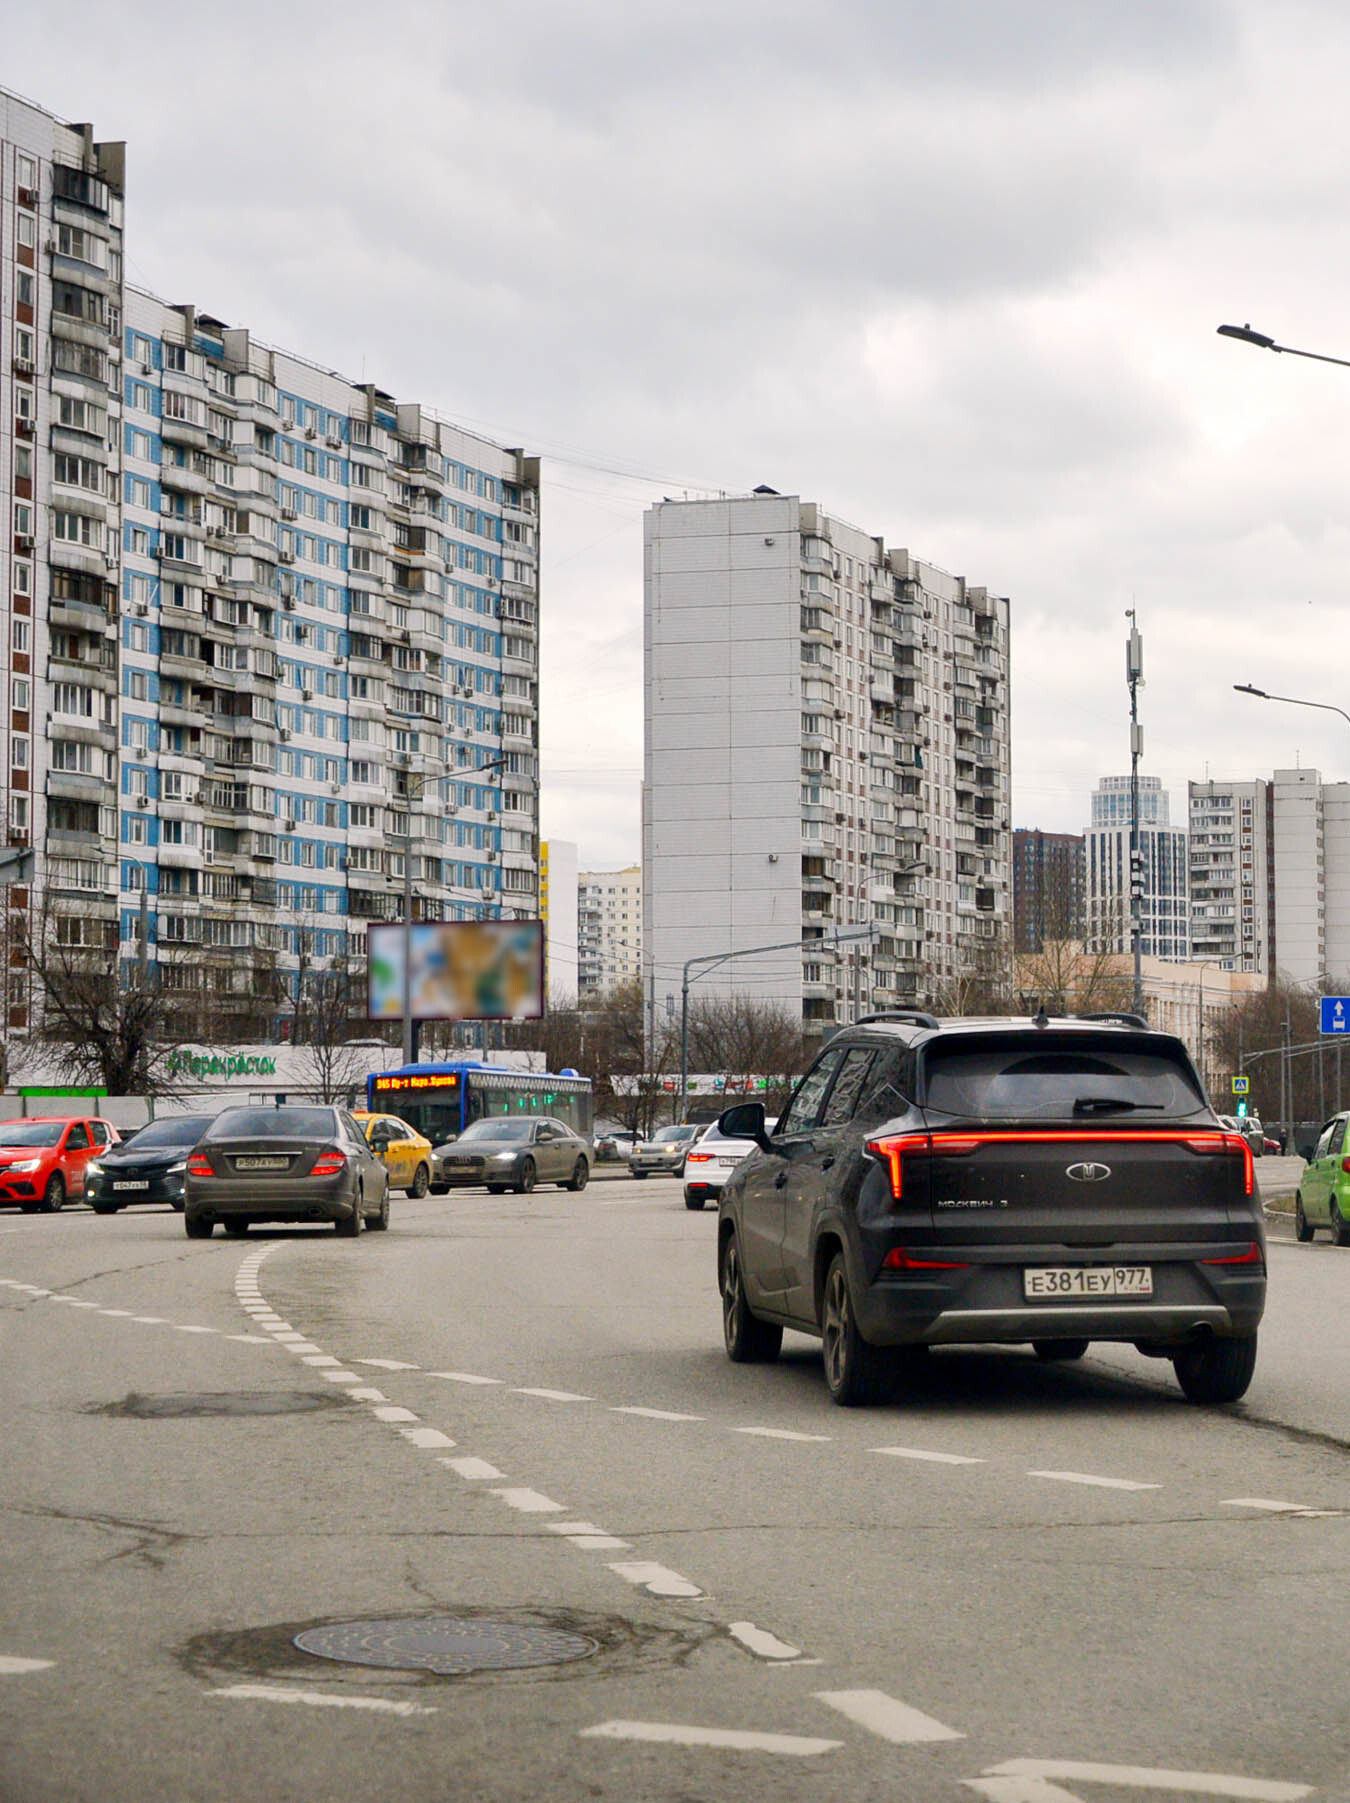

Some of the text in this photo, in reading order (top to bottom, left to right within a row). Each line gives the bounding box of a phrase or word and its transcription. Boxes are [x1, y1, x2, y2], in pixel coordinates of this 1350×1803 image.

[938, 1200, 1008, 1208] МОСКВИЧ 3
[1116, 1269, 1145, 1285] 977
